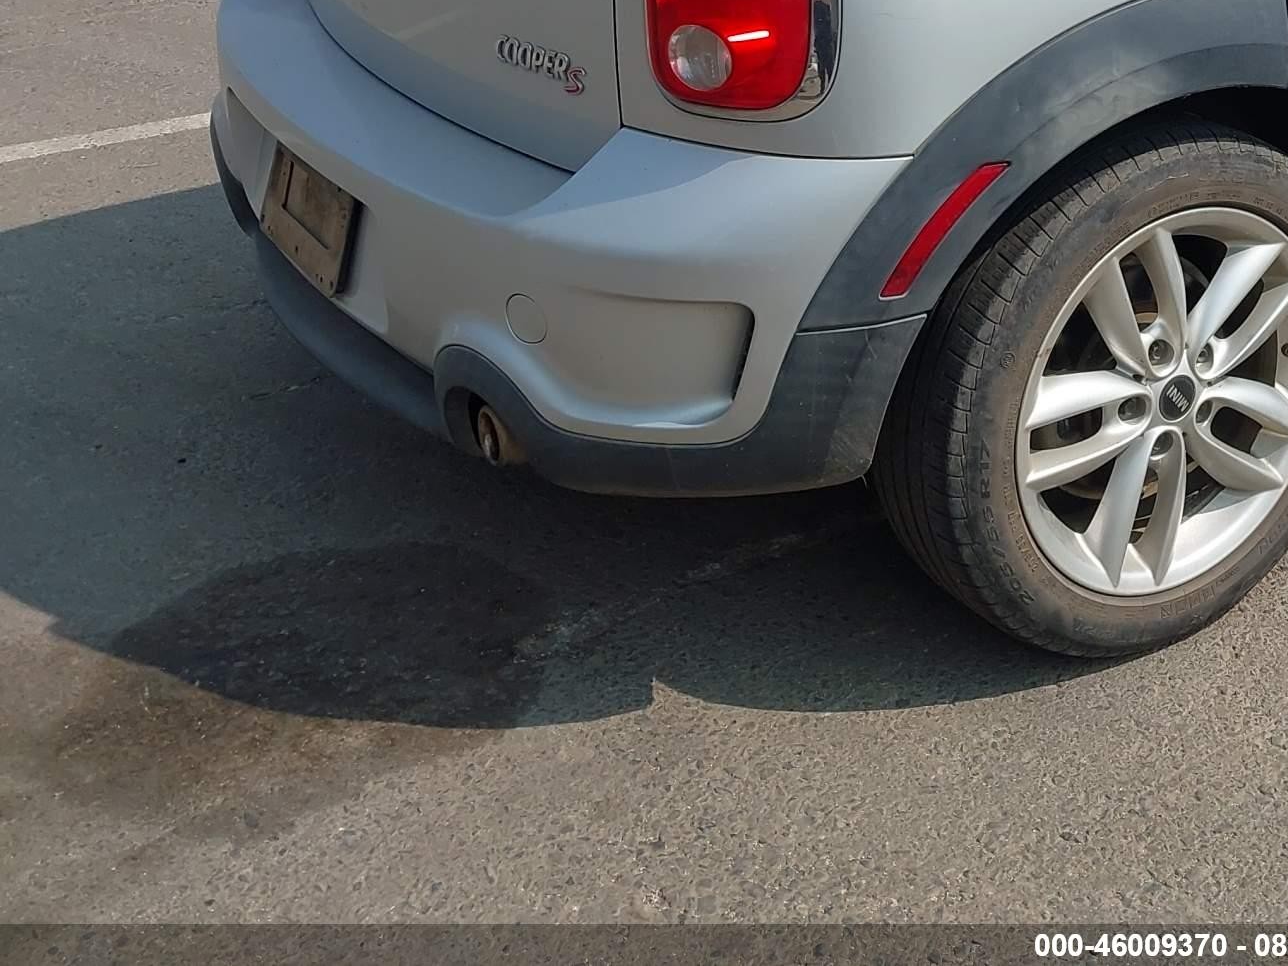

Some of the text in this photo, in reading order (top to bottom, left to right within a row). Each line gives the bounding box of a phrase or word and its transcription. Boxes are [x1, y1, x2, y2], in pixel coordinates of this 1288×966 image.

[496, 34, 587, 95] COOPER S
[1166, 383, 1190, 412] MINI
